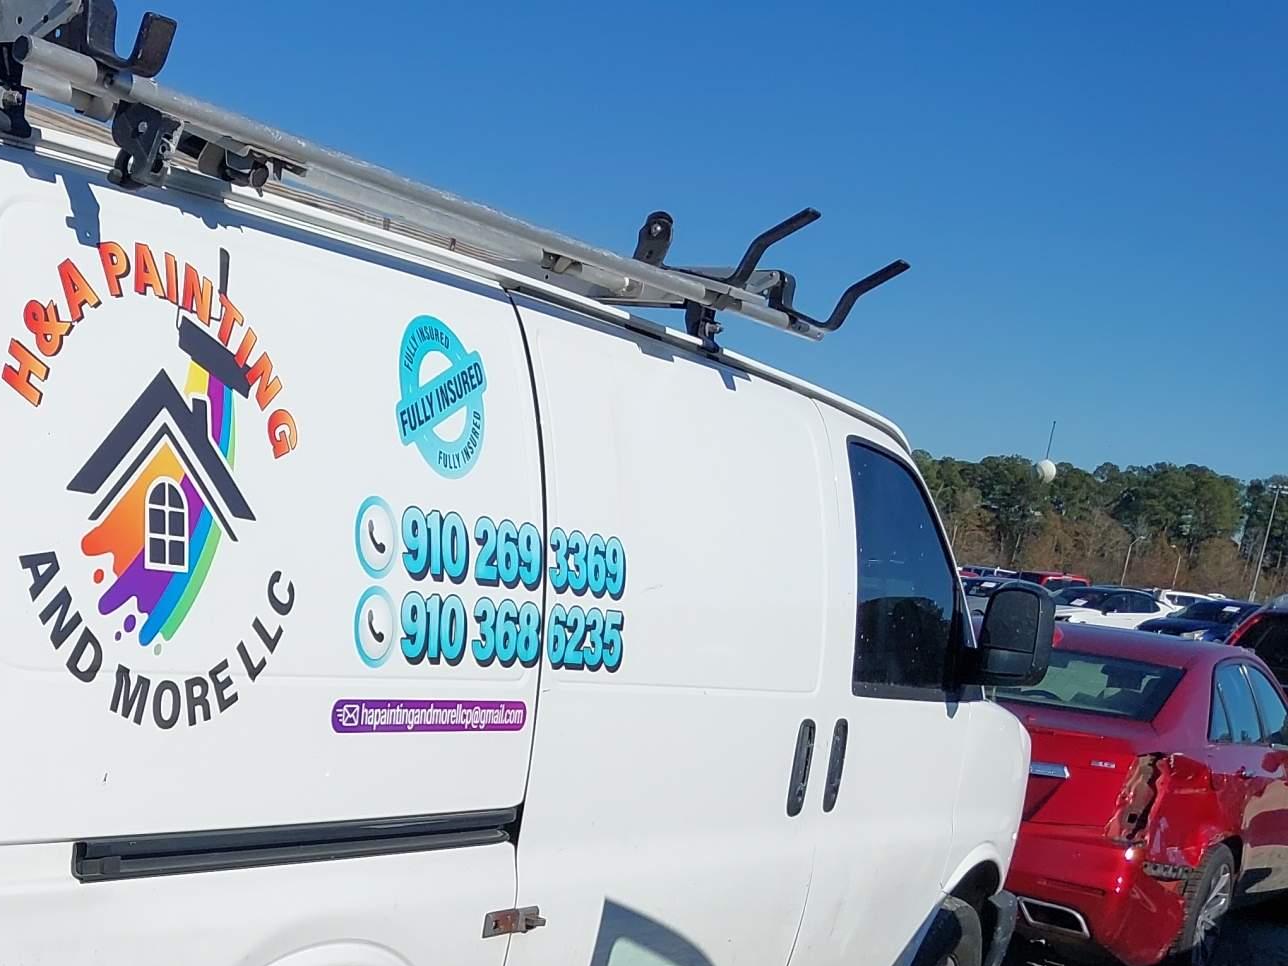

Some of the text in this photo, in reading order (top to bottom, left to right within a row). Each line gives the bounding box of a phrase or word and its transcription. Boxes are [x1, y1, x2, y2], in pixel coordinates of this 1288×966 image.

[1, 240, 298, 459] H&A PAINTING
[404, 326, 449, 372] FULLY INSURED
[400, 362, 483, 437] FULLY INSURED
[438, 410, 481, 470] FULLY INSURED
[401, 505, 626, 600] 910 269 3369
[19, 550, 296, 730] AND MORE LLC
[400, 591, 624, 673] 910 368 6235
[361, 703, 523, 730] hapaintingandmorellcp@gmail.com
